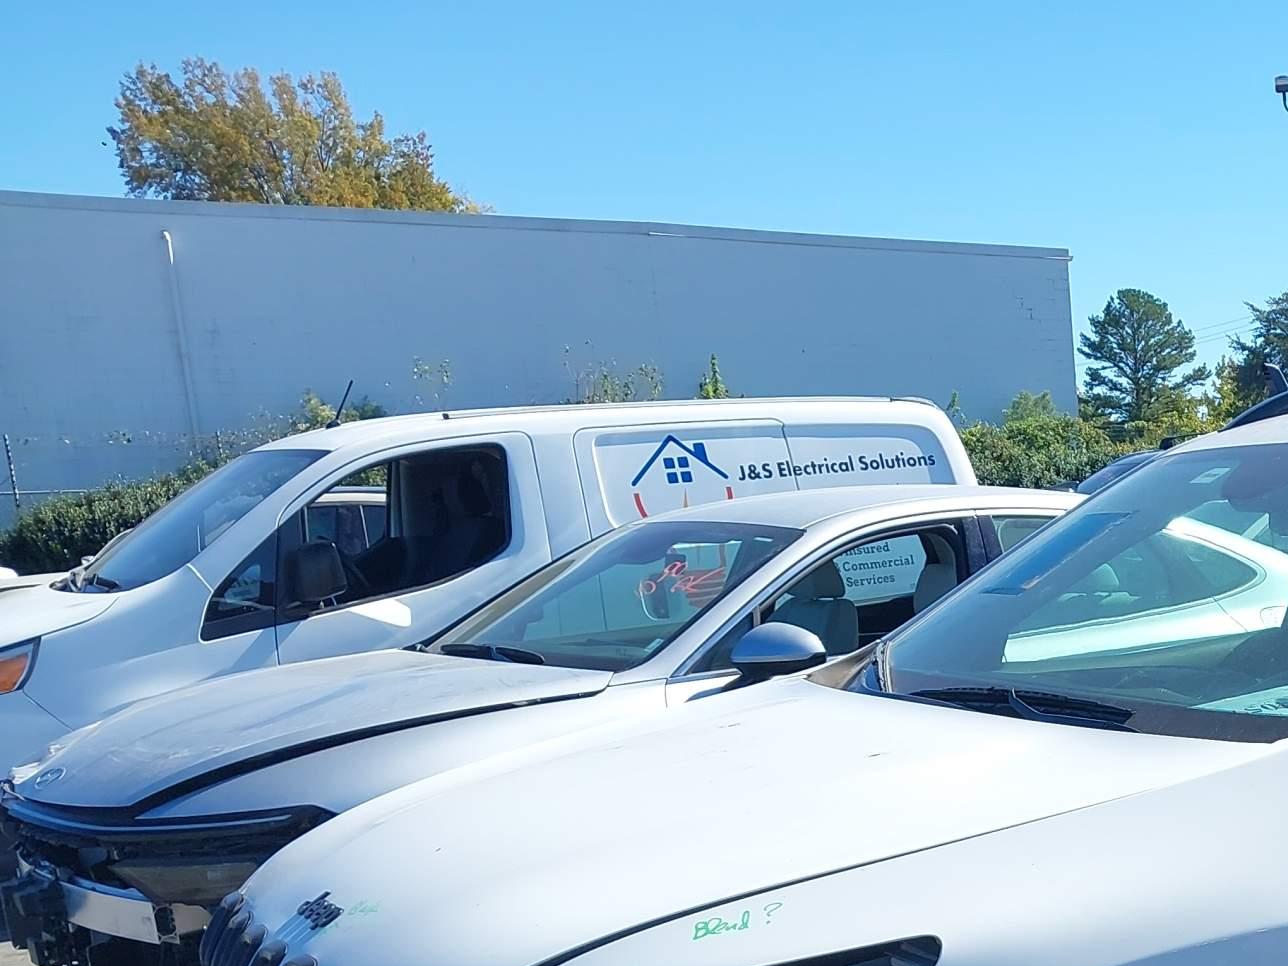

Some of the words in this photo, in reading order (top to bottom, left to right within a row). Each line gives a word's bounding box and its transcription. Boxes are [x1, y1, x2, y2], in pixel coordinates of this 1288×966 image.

[738, 463, 773, 481] J&S
[776, 455, 855, 478] Electrical
[859, 452, 936, 471] Solutions
[842, 554, 915, 572] Commercial
[846, 574, 896, 588] Services
[763, 902, 783, 925] ?
